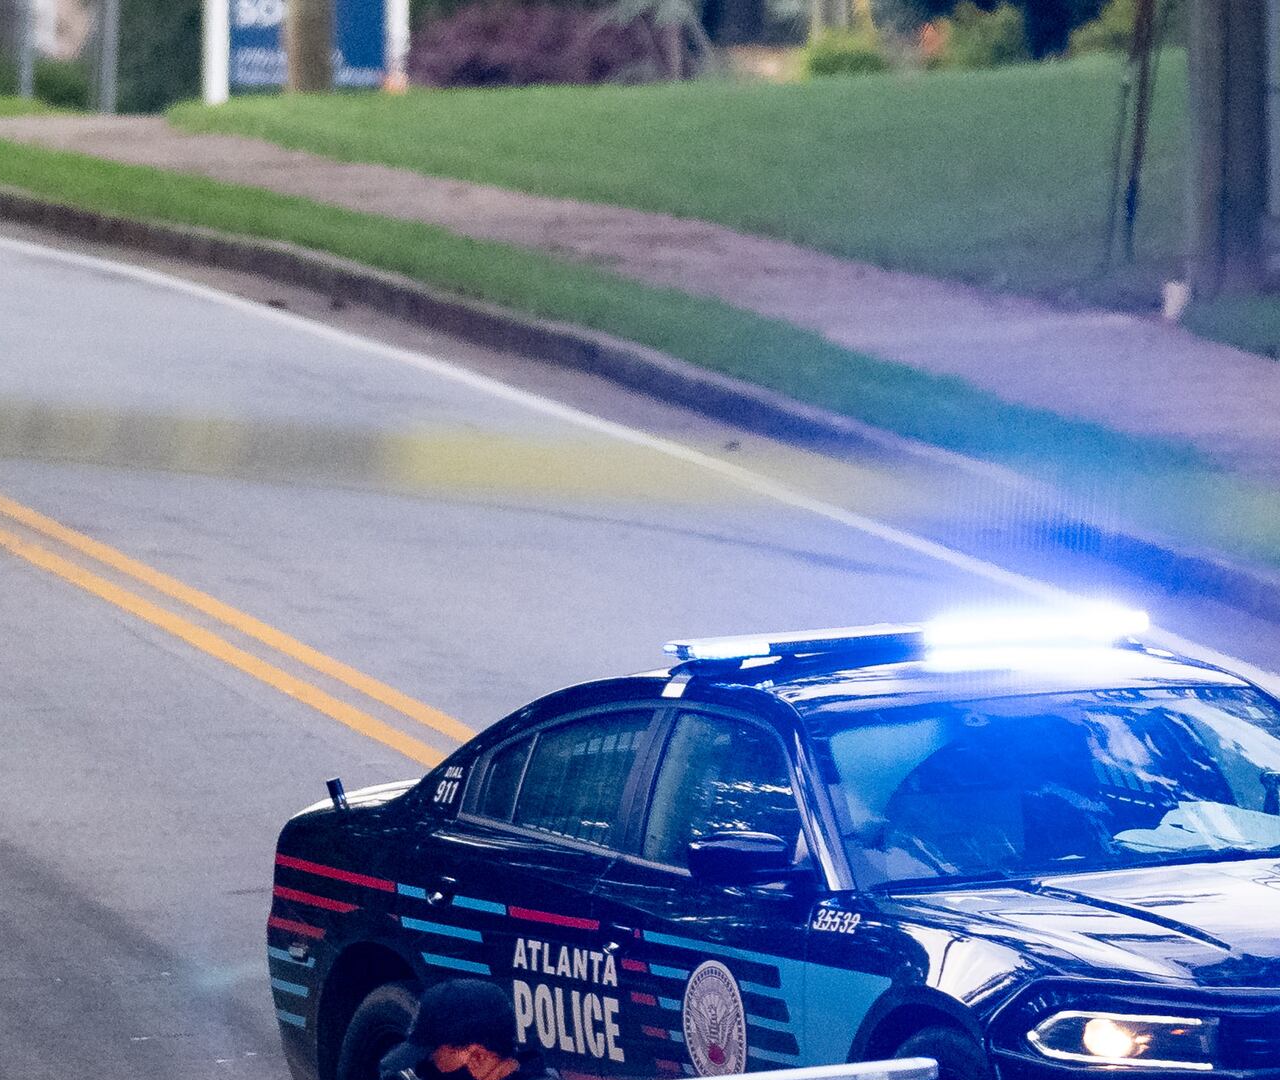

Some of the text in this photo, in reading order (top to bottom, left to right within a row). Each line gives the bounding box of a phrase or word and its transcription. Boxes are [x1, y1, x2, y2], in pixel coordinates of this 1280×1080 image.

[433, 780, 460, 804] 911
[812, 908, 861, 935] 35532
[512, 937, 618, 987] ATLANTA
[512, 979, 625, 1063] POLICE
